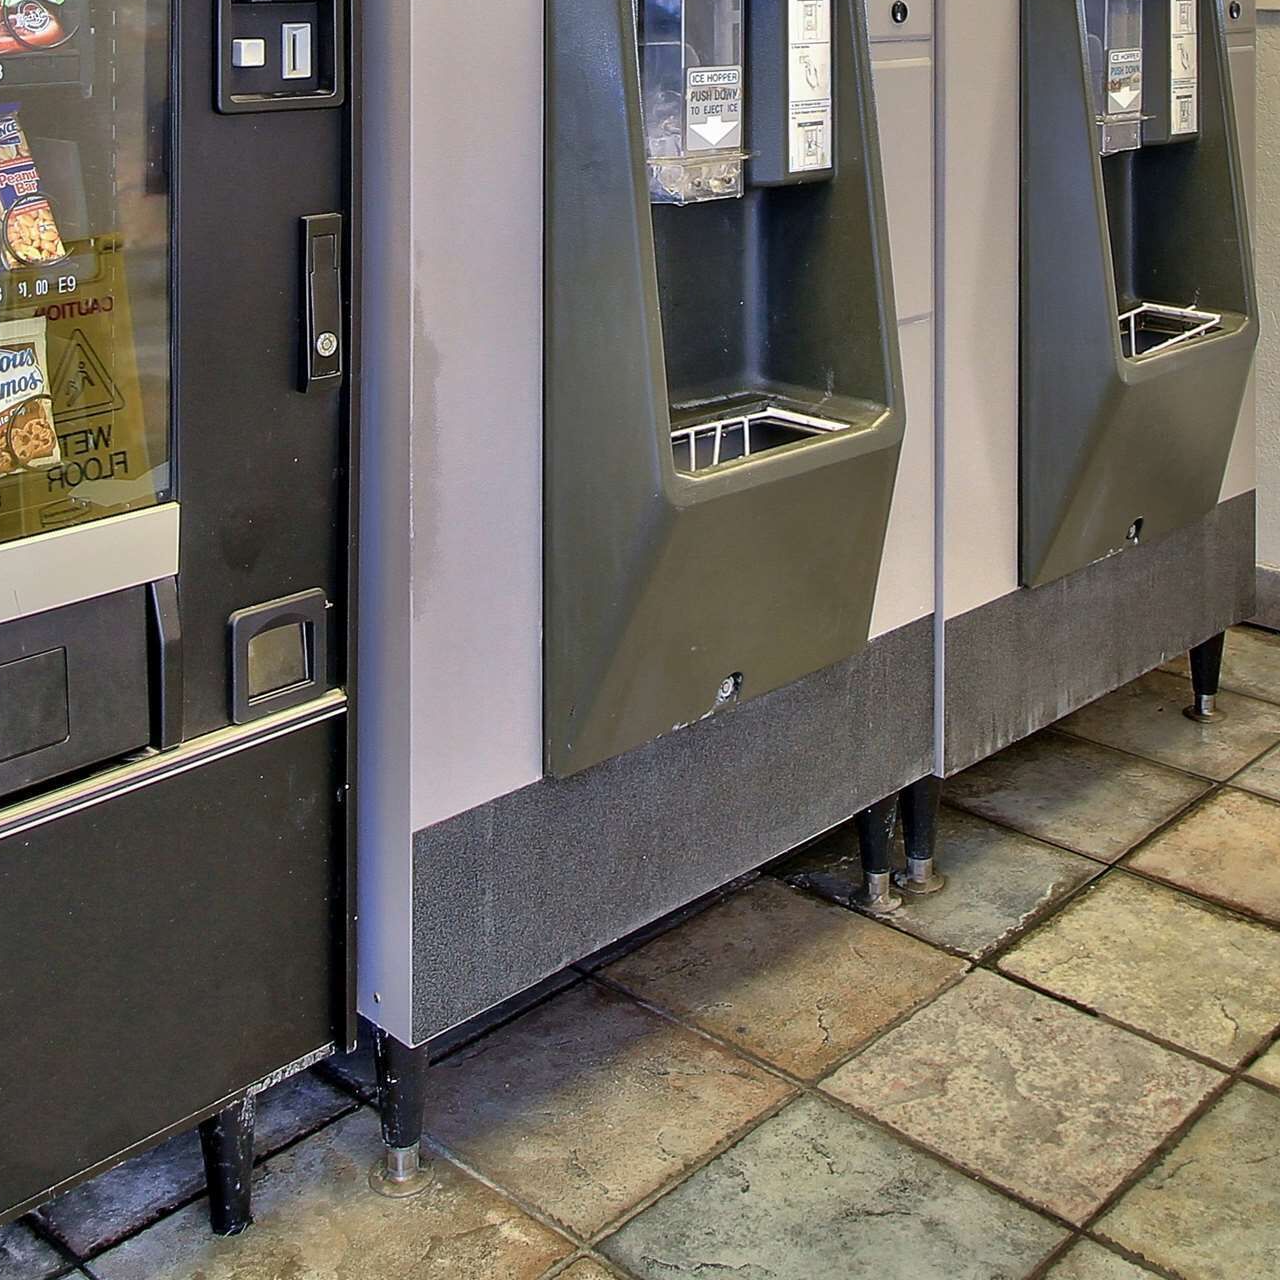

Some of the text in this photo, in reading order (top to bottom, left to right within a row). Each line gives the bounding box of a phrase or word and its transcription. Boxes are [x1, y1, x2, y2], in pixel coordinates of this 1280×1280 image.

[692, 72, 738, 84] ICE HOPPER
[690, 87, 738, 103] PUSH DOWN
[690, 102, 738, 116] TO EJECT ICE
[14, 181, 38, 197] Bar
[18, 275, 77, 299] $1.00 E9
